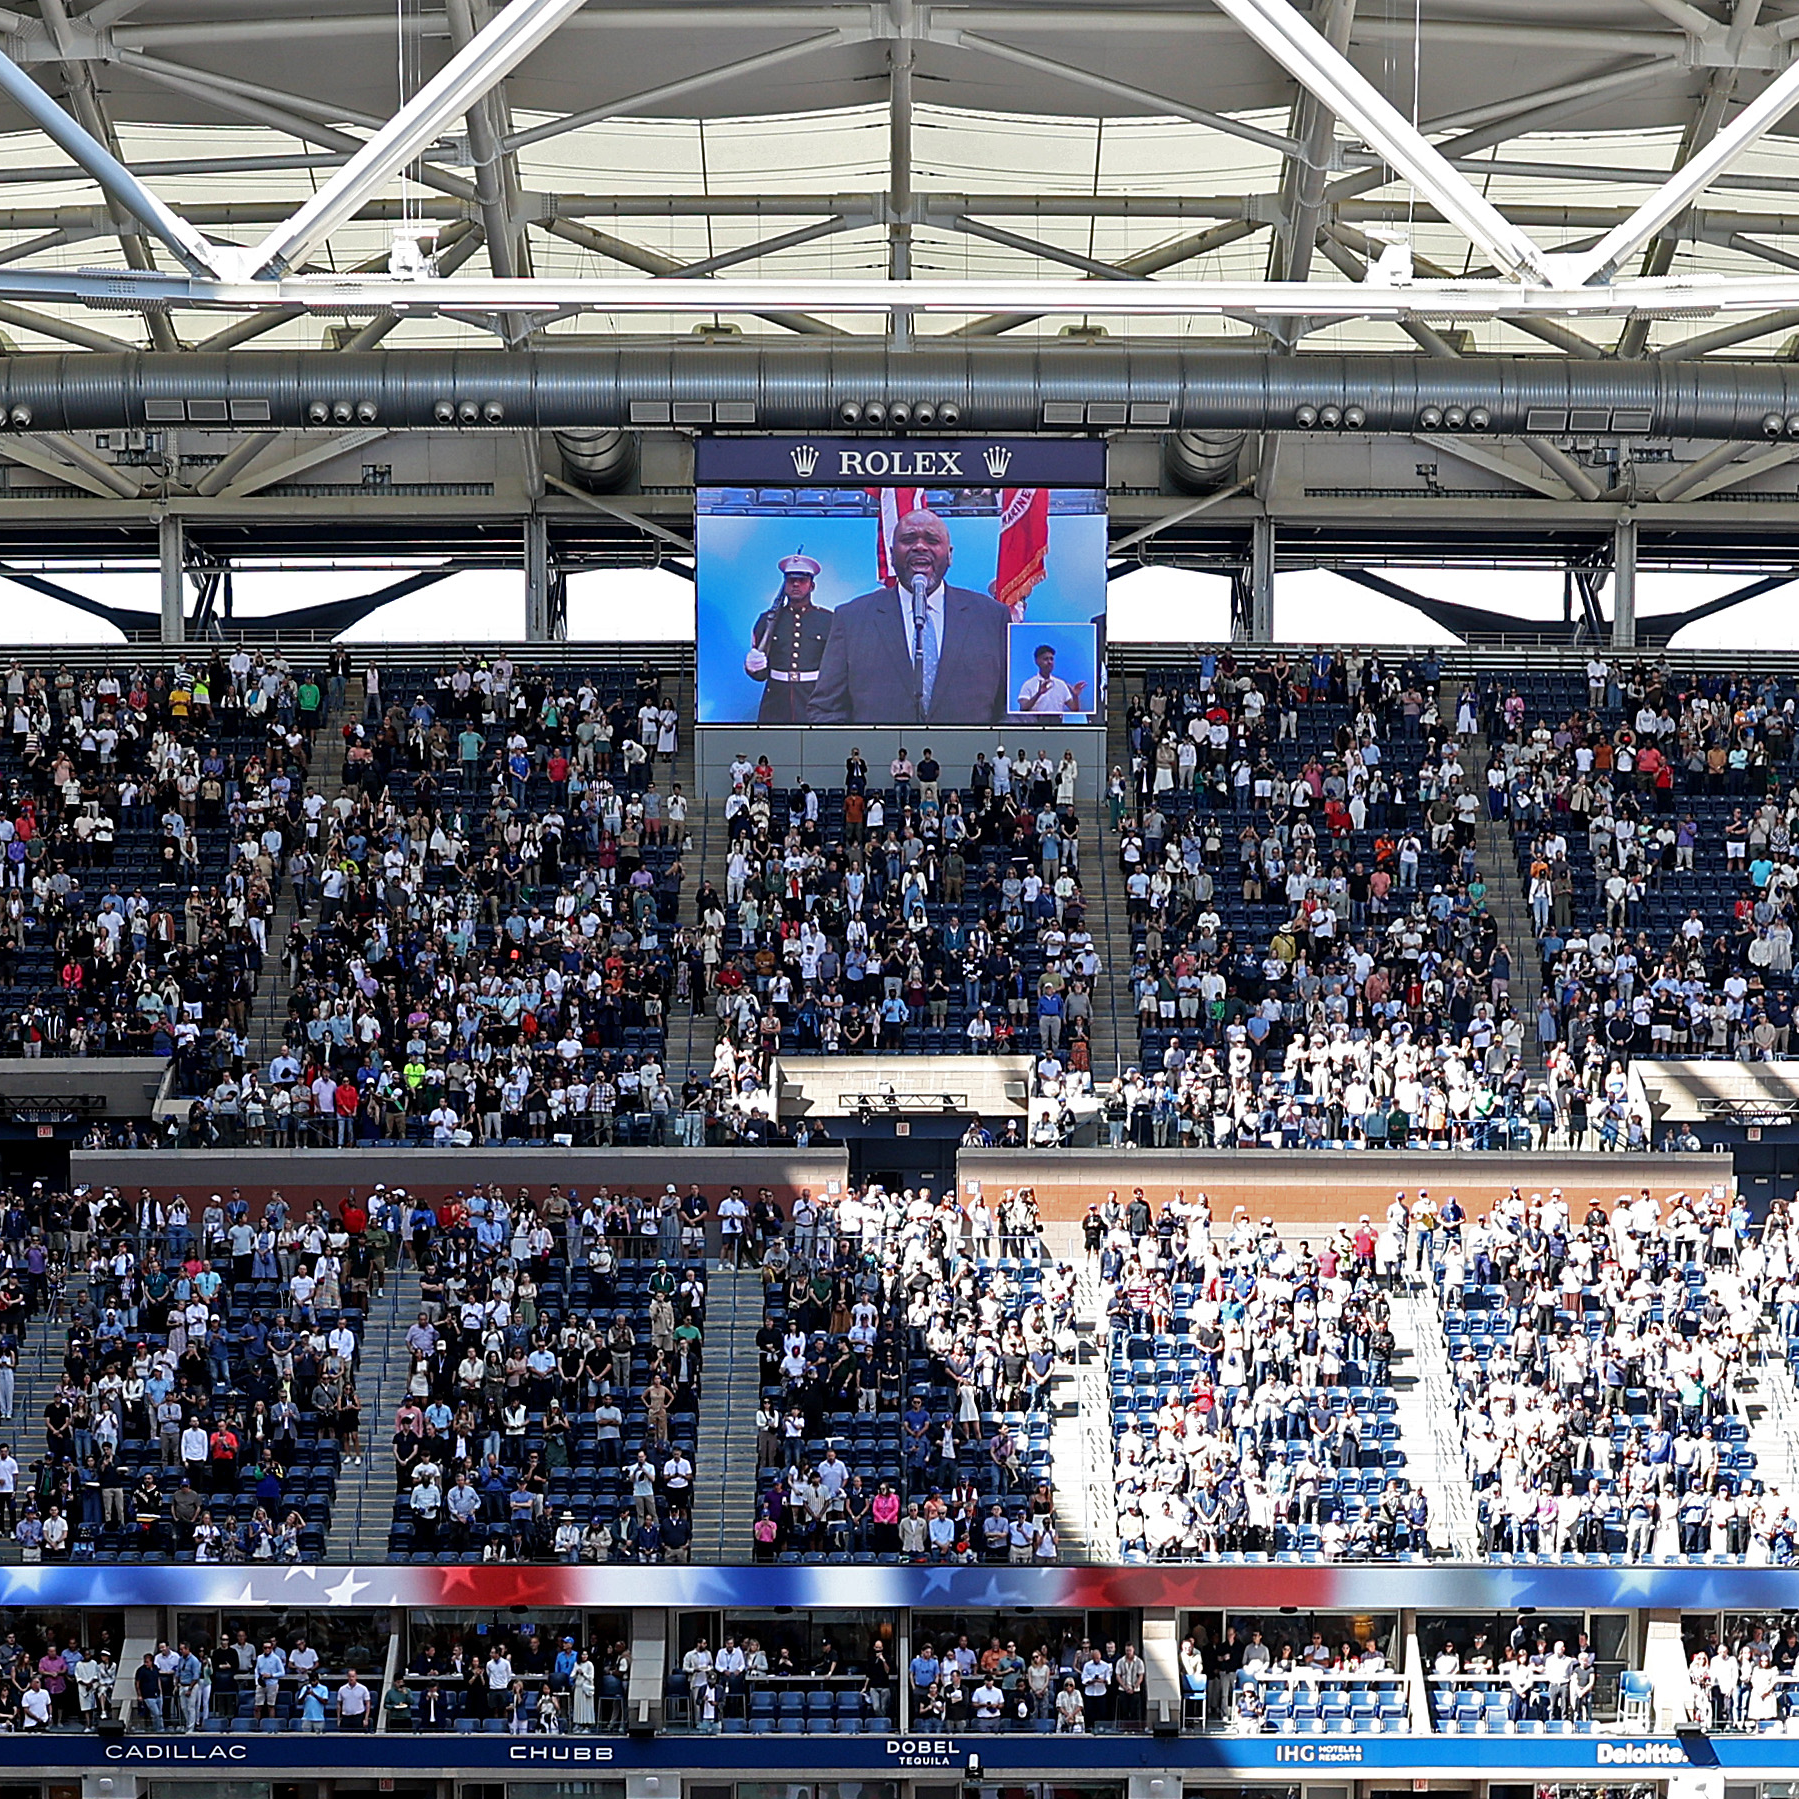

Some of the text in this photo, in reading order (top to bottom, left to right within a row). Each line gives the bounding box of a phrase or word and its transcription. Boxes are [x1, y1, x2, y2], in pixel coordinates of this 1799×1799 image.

[839, 451, 963, 476] ROLEX
[105, 1745, 247, 1760] CADILLAC
[509, 1745, 614, 1761] CHUBB
[886, 1740, 961, 1754] DOBEL
[1276, 1744, 1316, 1763] IHG
[1596, 1743, 1690, 1765] Deloitte.
[898, 1756, 950, 1766] TEQUILA
[1318, 1753, 1363, 1763] RESORTS
